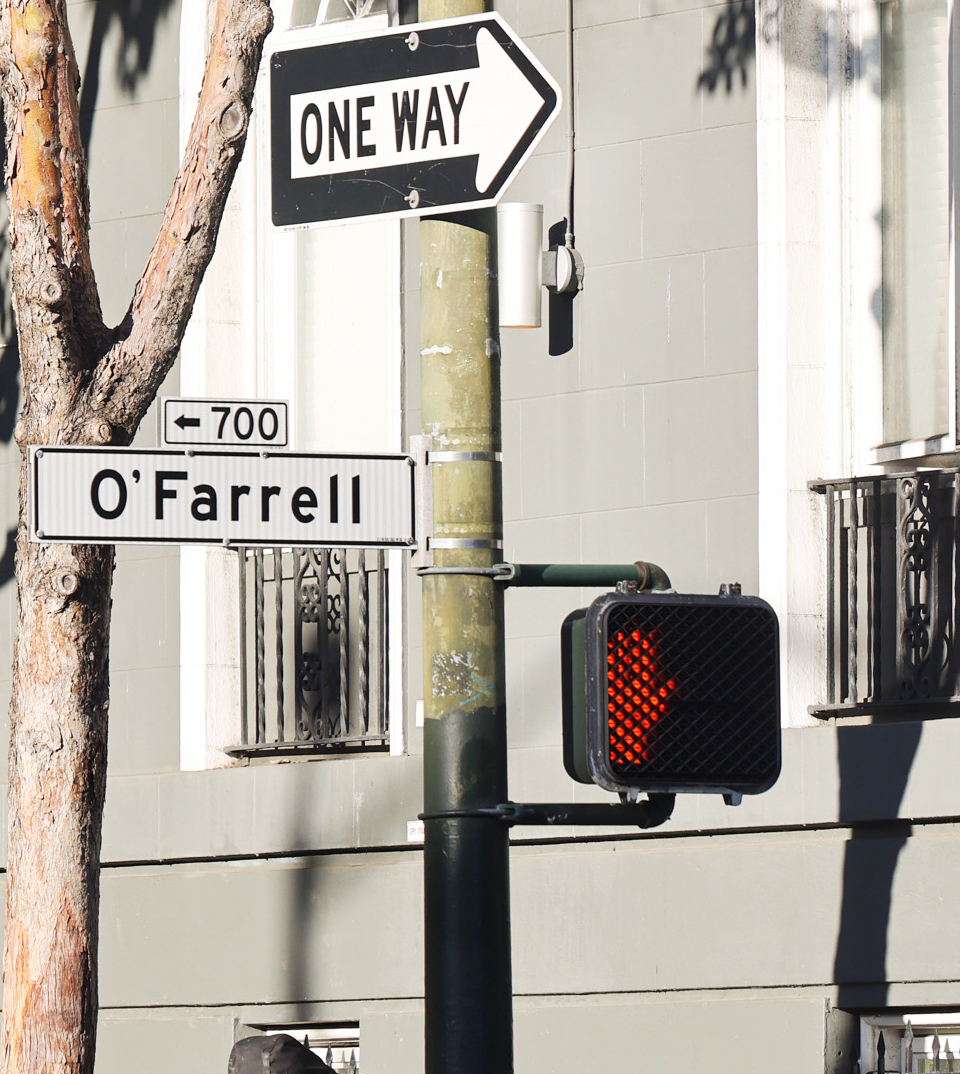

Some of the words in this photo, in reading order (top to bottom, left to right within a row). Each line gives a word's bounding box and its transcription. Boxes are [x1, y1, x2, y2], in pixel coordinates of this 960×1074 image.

[300, 95, 376, 165] ONE
[392, 81, 470, 152] WAY
[211, 406, 279, 441] 700
[90, 468, 361, 524] O'Farrell
